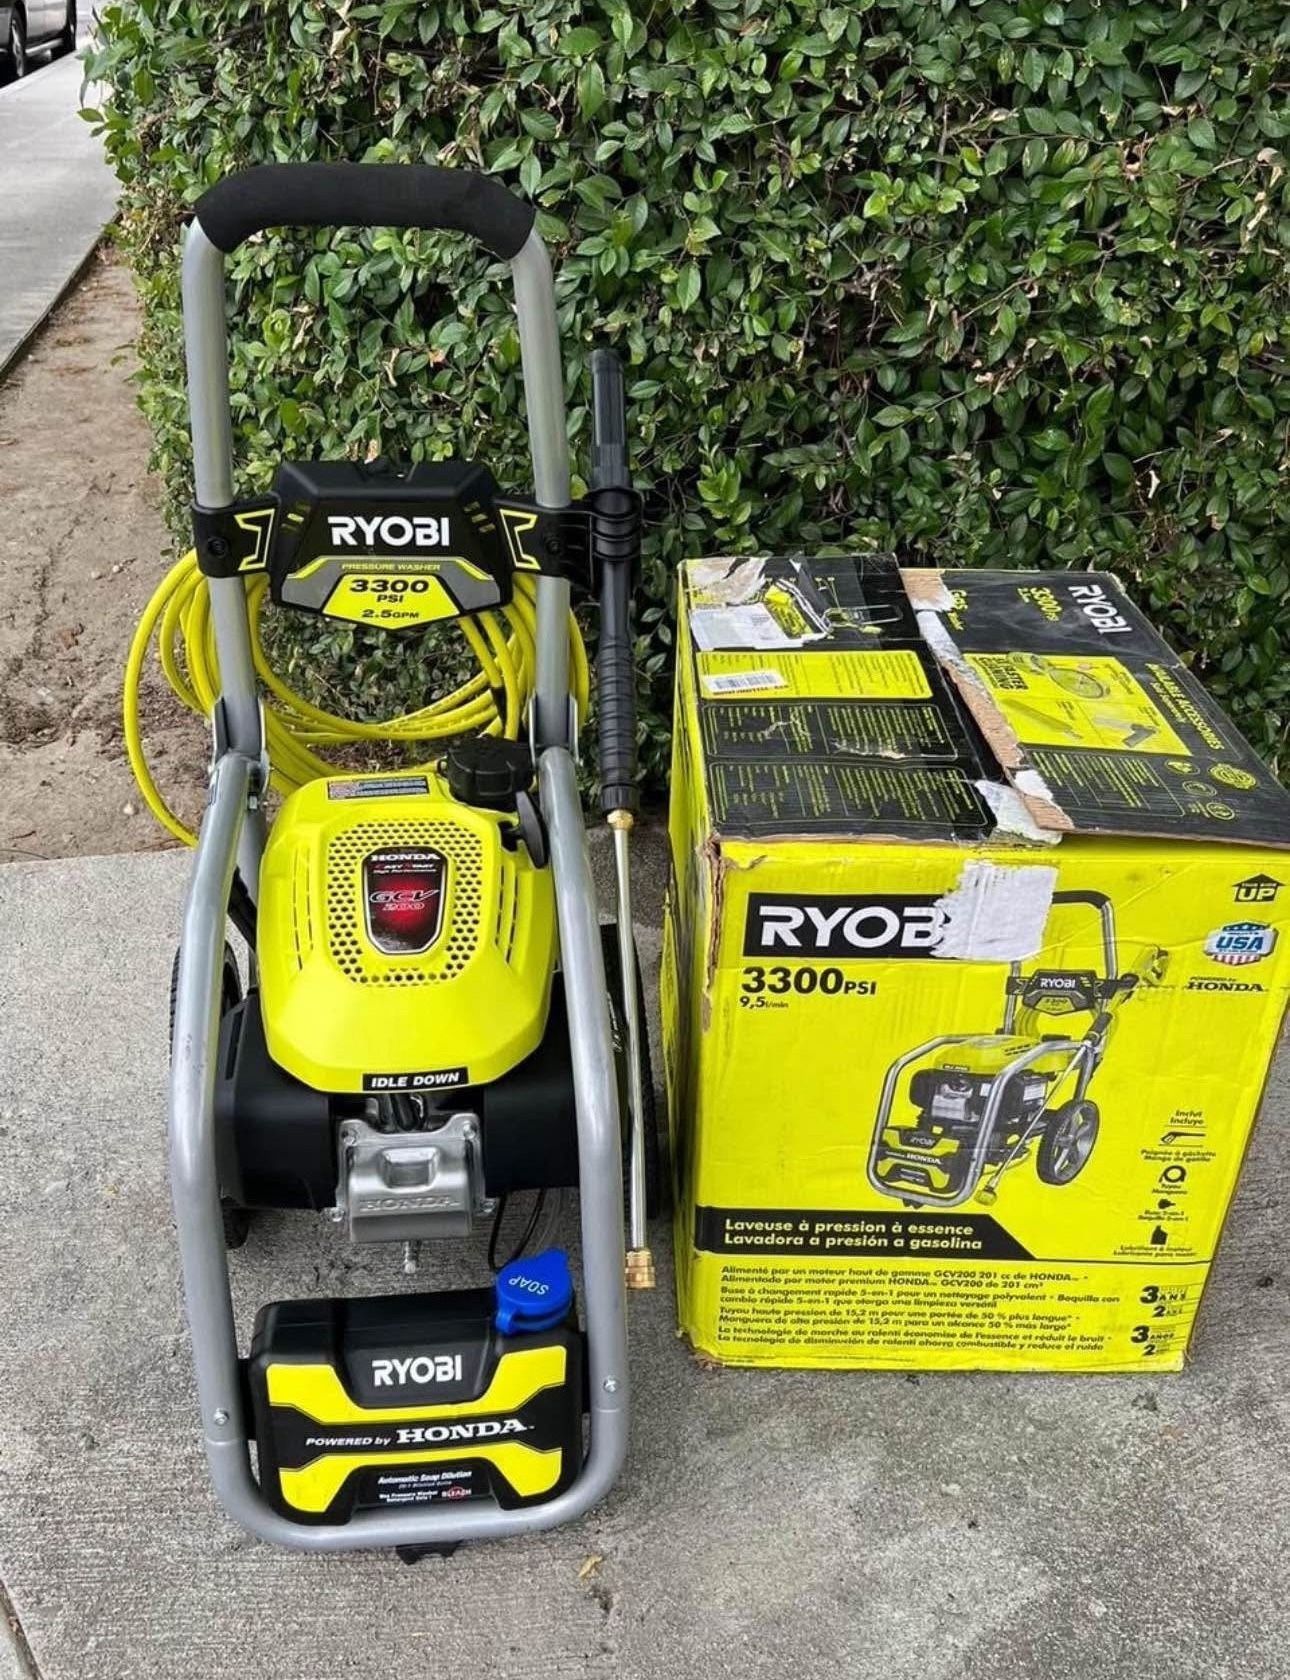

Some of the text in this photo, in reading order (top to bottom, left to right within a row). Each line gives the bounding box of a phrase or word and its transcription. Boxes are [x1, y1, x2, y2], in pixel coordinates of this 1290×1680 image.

[328, 516, 450, 546] RYOBI
[342, 563, 440, 571] PRESSURE WASHER
[350, 579, 429, 593] 3300
[377, 594, 404, 603] PSI
[362, 608, 420, 618] 2.5GPM
[1068, 585, 1132, 634] RYOBI
[371, 853, 441, 861] HONDA
[369, 889, 440, 903] GCV
[1237, 888, 1276, 901] UP
[759, 906, 945, 948] RYOB
[1216, 936, 1264, 950] USA
[1040, 979, 1076, 988] RYOBI
[1186, 981, 1265, 992] HONDA
[371, 1072, 460, 1088] IDLE DOWN
[359, 1196, 461, 1212] HONDA
[725, 1219, 974, 1236] Laveuse à pression à essence
[724, 1233, 982, 1251] Lavadora a presión a gasolina
[721, 1266, 769, 1275] Alimenté
[771, 1268, 790, 1276] par
[809, 1268, 845, 1276] moteur
[848, 1268, 872, 1276] haut
[891, 1270, 930, 1279] gamme
[934, 1270, 976, 1278] GCV200
[979, 1271, 997, 1279] 201
[1013, 1272, 1026, 1280] de
[508, 1275, 549, 1295] SOAP
[721, 1275, 781, 1284] Alimentado
[784, 1277, 801, 1286] por
[805, 1276, 836, 1285] motor
[838, 1277, 886, 1286] premium
[941, 1279, 982, 1288] GCV200
[985, 1280, 999, 1288] de
[1002, 1280, 1020, 1289] 201
[757, 1287, 822, 1297] changement
[824, 1288, 858, 1298] rapide
[860, 1289, 894, 1297] 5-en-1
[896, 1290, 920, 1299] pour
[939, 1292, 990, 1301] nettoyage
[993, 1292, 1047, 1302] polyvalent
[1140, 1285, 1159, 1304] 3
[720, 1296, 758, 1304] cambio
[760, 1296, 794, 1306] rápido
[833, 1299, 853, 1307] que
[913, 1299, 957, 1308] limpieza
[751, 1307, 781, 1316] haute
[784, 1308, 826, 1317] pression
[828, 1308, 842, 1316] de
[881, 1310, 905, 1318] pour
[965, 1312, 978, 1320] de
[981, 1312, 994, 1320] 50
[1008, 1313, 1030, 1322] plus
[1151, 1305, 1167, 1318] 2
[719, 1315, 772, 1326] Manguera
[774, 1316, 788, 1324] de
[812, 1317, 850, 1326] presión
[852, 1318, 865, 1326] de
[904, 1320, 929, 1328] para
[988, 1320, 1001, 1329] 50
[718, 1326, 731, 1334] La
[732, 1326, 792, 1336] technologie
[794, 1328, 808, 1336] de
[810, 1328, 848, 1336] marche
[1022, 1332, 1033, 1340] et
[1068, 1334, 1077, 1342] le
[1130, 1325, 1150, 1343] 3
[718, 1334, 730, 1342] La
[788, 1336, 801, 1344] de
[866, 1337, 880, 1345] de
[1027, 1342, 1062, 1350] reduce
[1064, 1342, 1074, 1350] el
[1142, 1344, 1156, 1356] 2
[371, 1355, 462, 1387] RYOBI
[306, 1437, 373, 1446] POWERED
[374, 1436, 391, 1446] by
[378, 1471, 472, 1484] Automatic Soap Dilution
